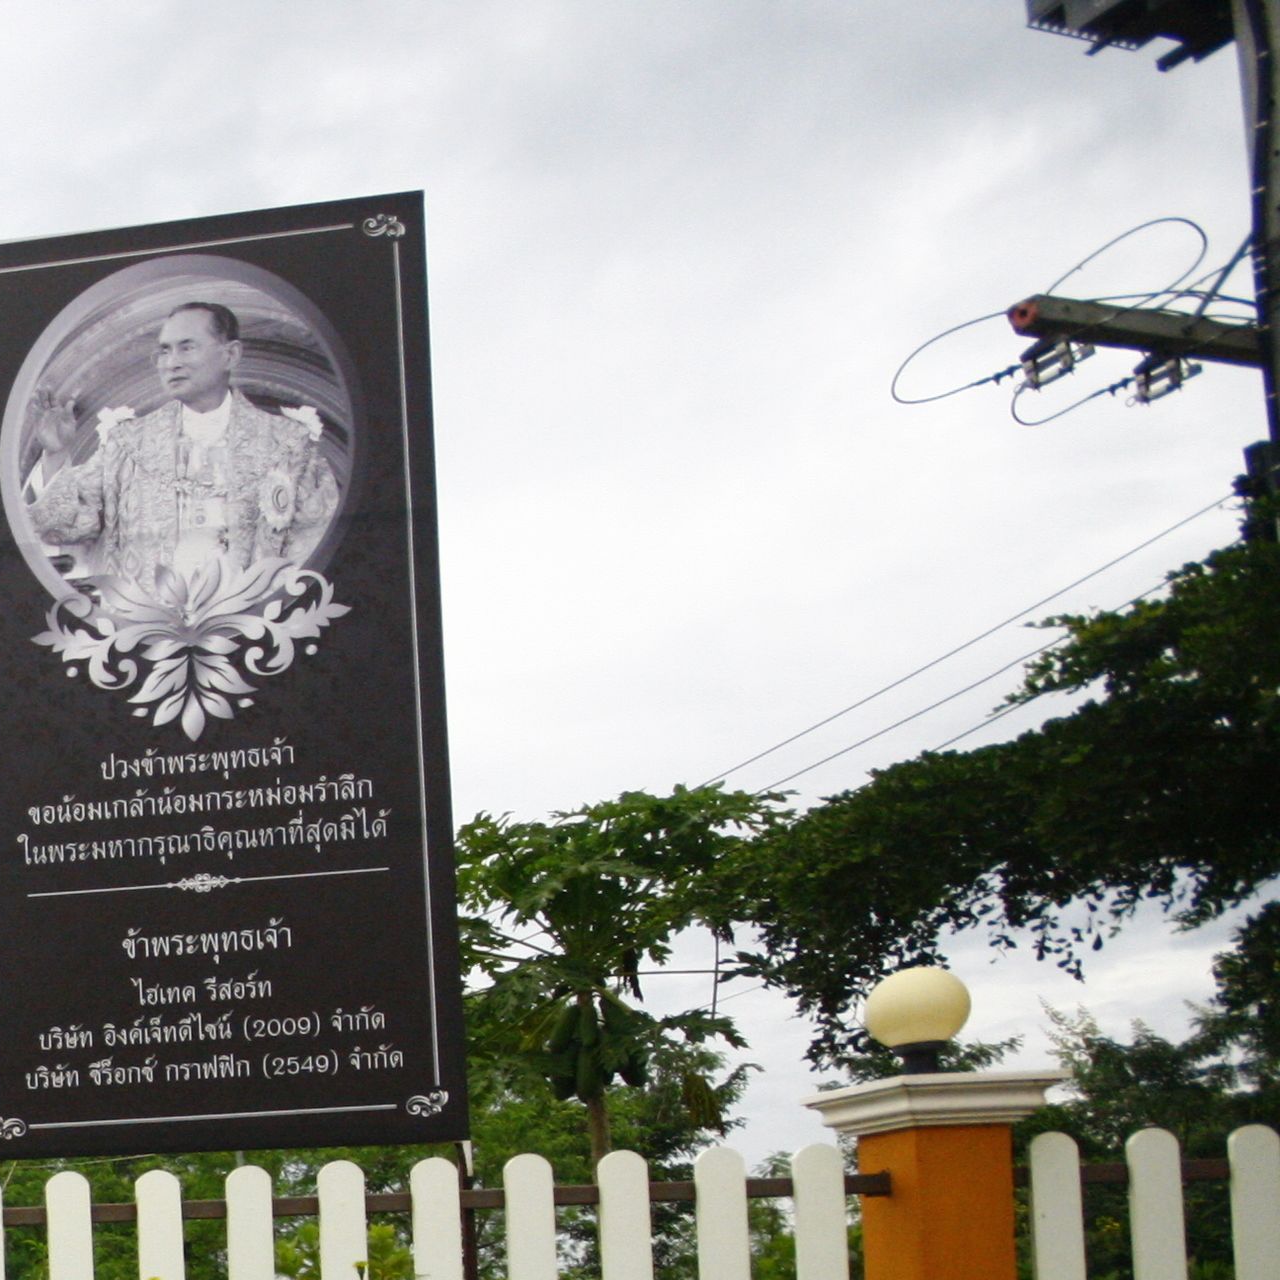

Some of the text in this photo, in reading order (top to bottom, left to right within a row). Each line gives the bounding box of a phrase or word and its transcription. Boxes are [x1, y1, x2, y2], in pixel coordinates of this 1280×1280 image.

[100, 736, 295, 781] ปวงข้าพระพุทธเจ้า
[27, 772, 373, 826] ขอน้อมเกล้าน้อมกระหม่อมรำลึก
[16, 806, 392, 867] ในพระมหากรุณาธิคุณหาที่สุดมิได้
[121, 917, 292, 965] ข้าพระพุทธเจ้า
[130, 969, 272, 1006] ไฮเทค รีสอร์ท
[38, 1024, 93, 1051] บริษัท
[243, 1011, 321, 1042] (2009)
[331, 1006, 386, 1032] จำกัด
[25, 1063, 80, 1090] บริษัท
[165, 1053, 251, 1082] กราฟฟิก
[262, 1049, 340, 1080] (2549)
[348, 1044, 404, 1071] จำกัด
